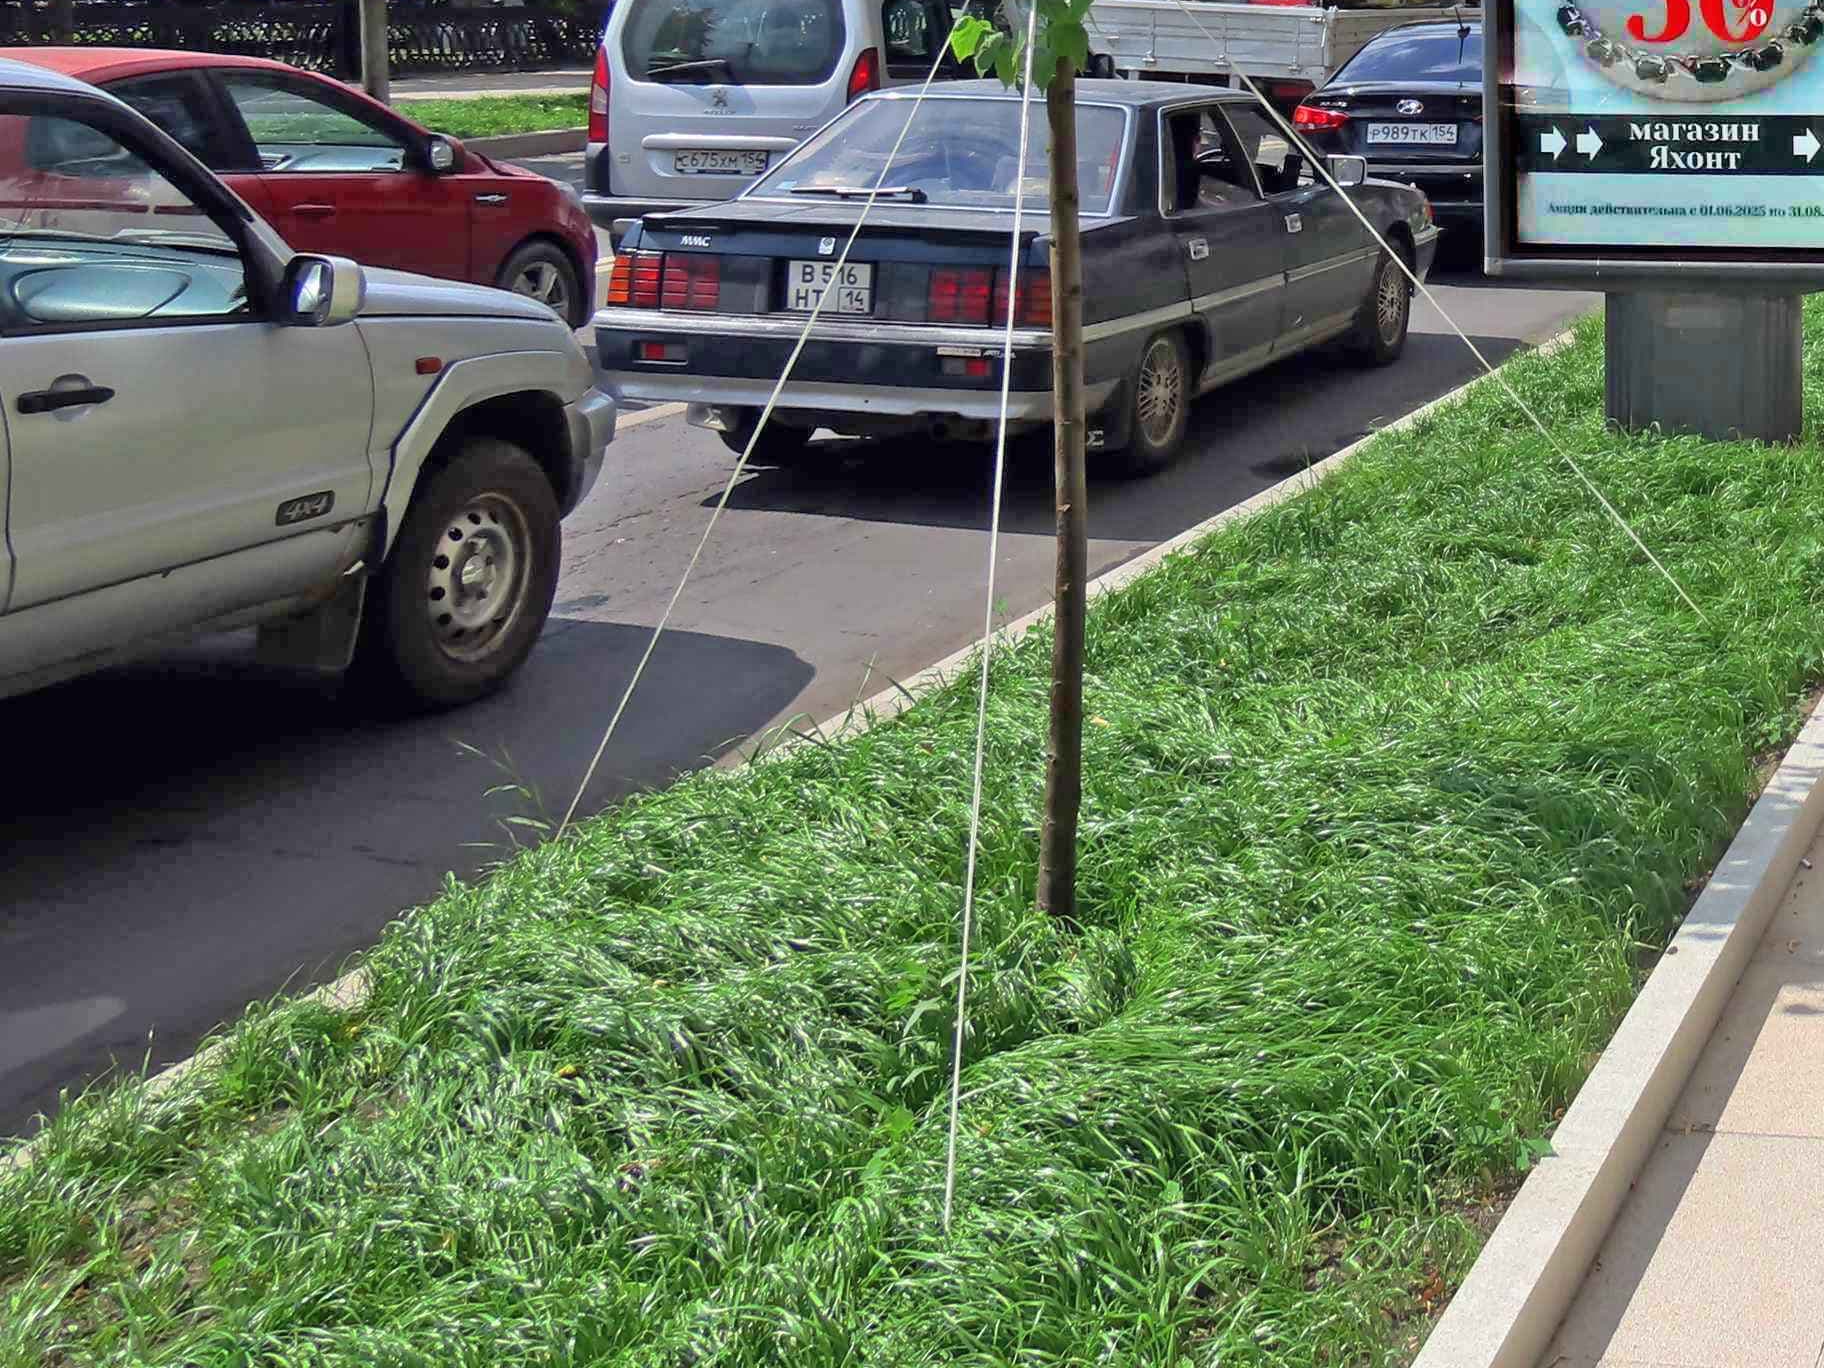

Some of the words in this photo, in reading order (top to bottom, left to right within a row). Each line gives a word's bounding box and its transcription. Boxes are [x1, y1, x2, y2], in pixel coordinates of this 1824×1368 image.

[1372, 126, 1428, 141] Р989ТК
[1432, 125, 1454, 138] 154
[1629, 122, 1760, 142] магазин
[1650, 146, 1742, 170] Яхонт
[1769, 207, 1786, 217] по
[680, 235, 711, 247] MMC
[846, 290, 864, 306] 14
